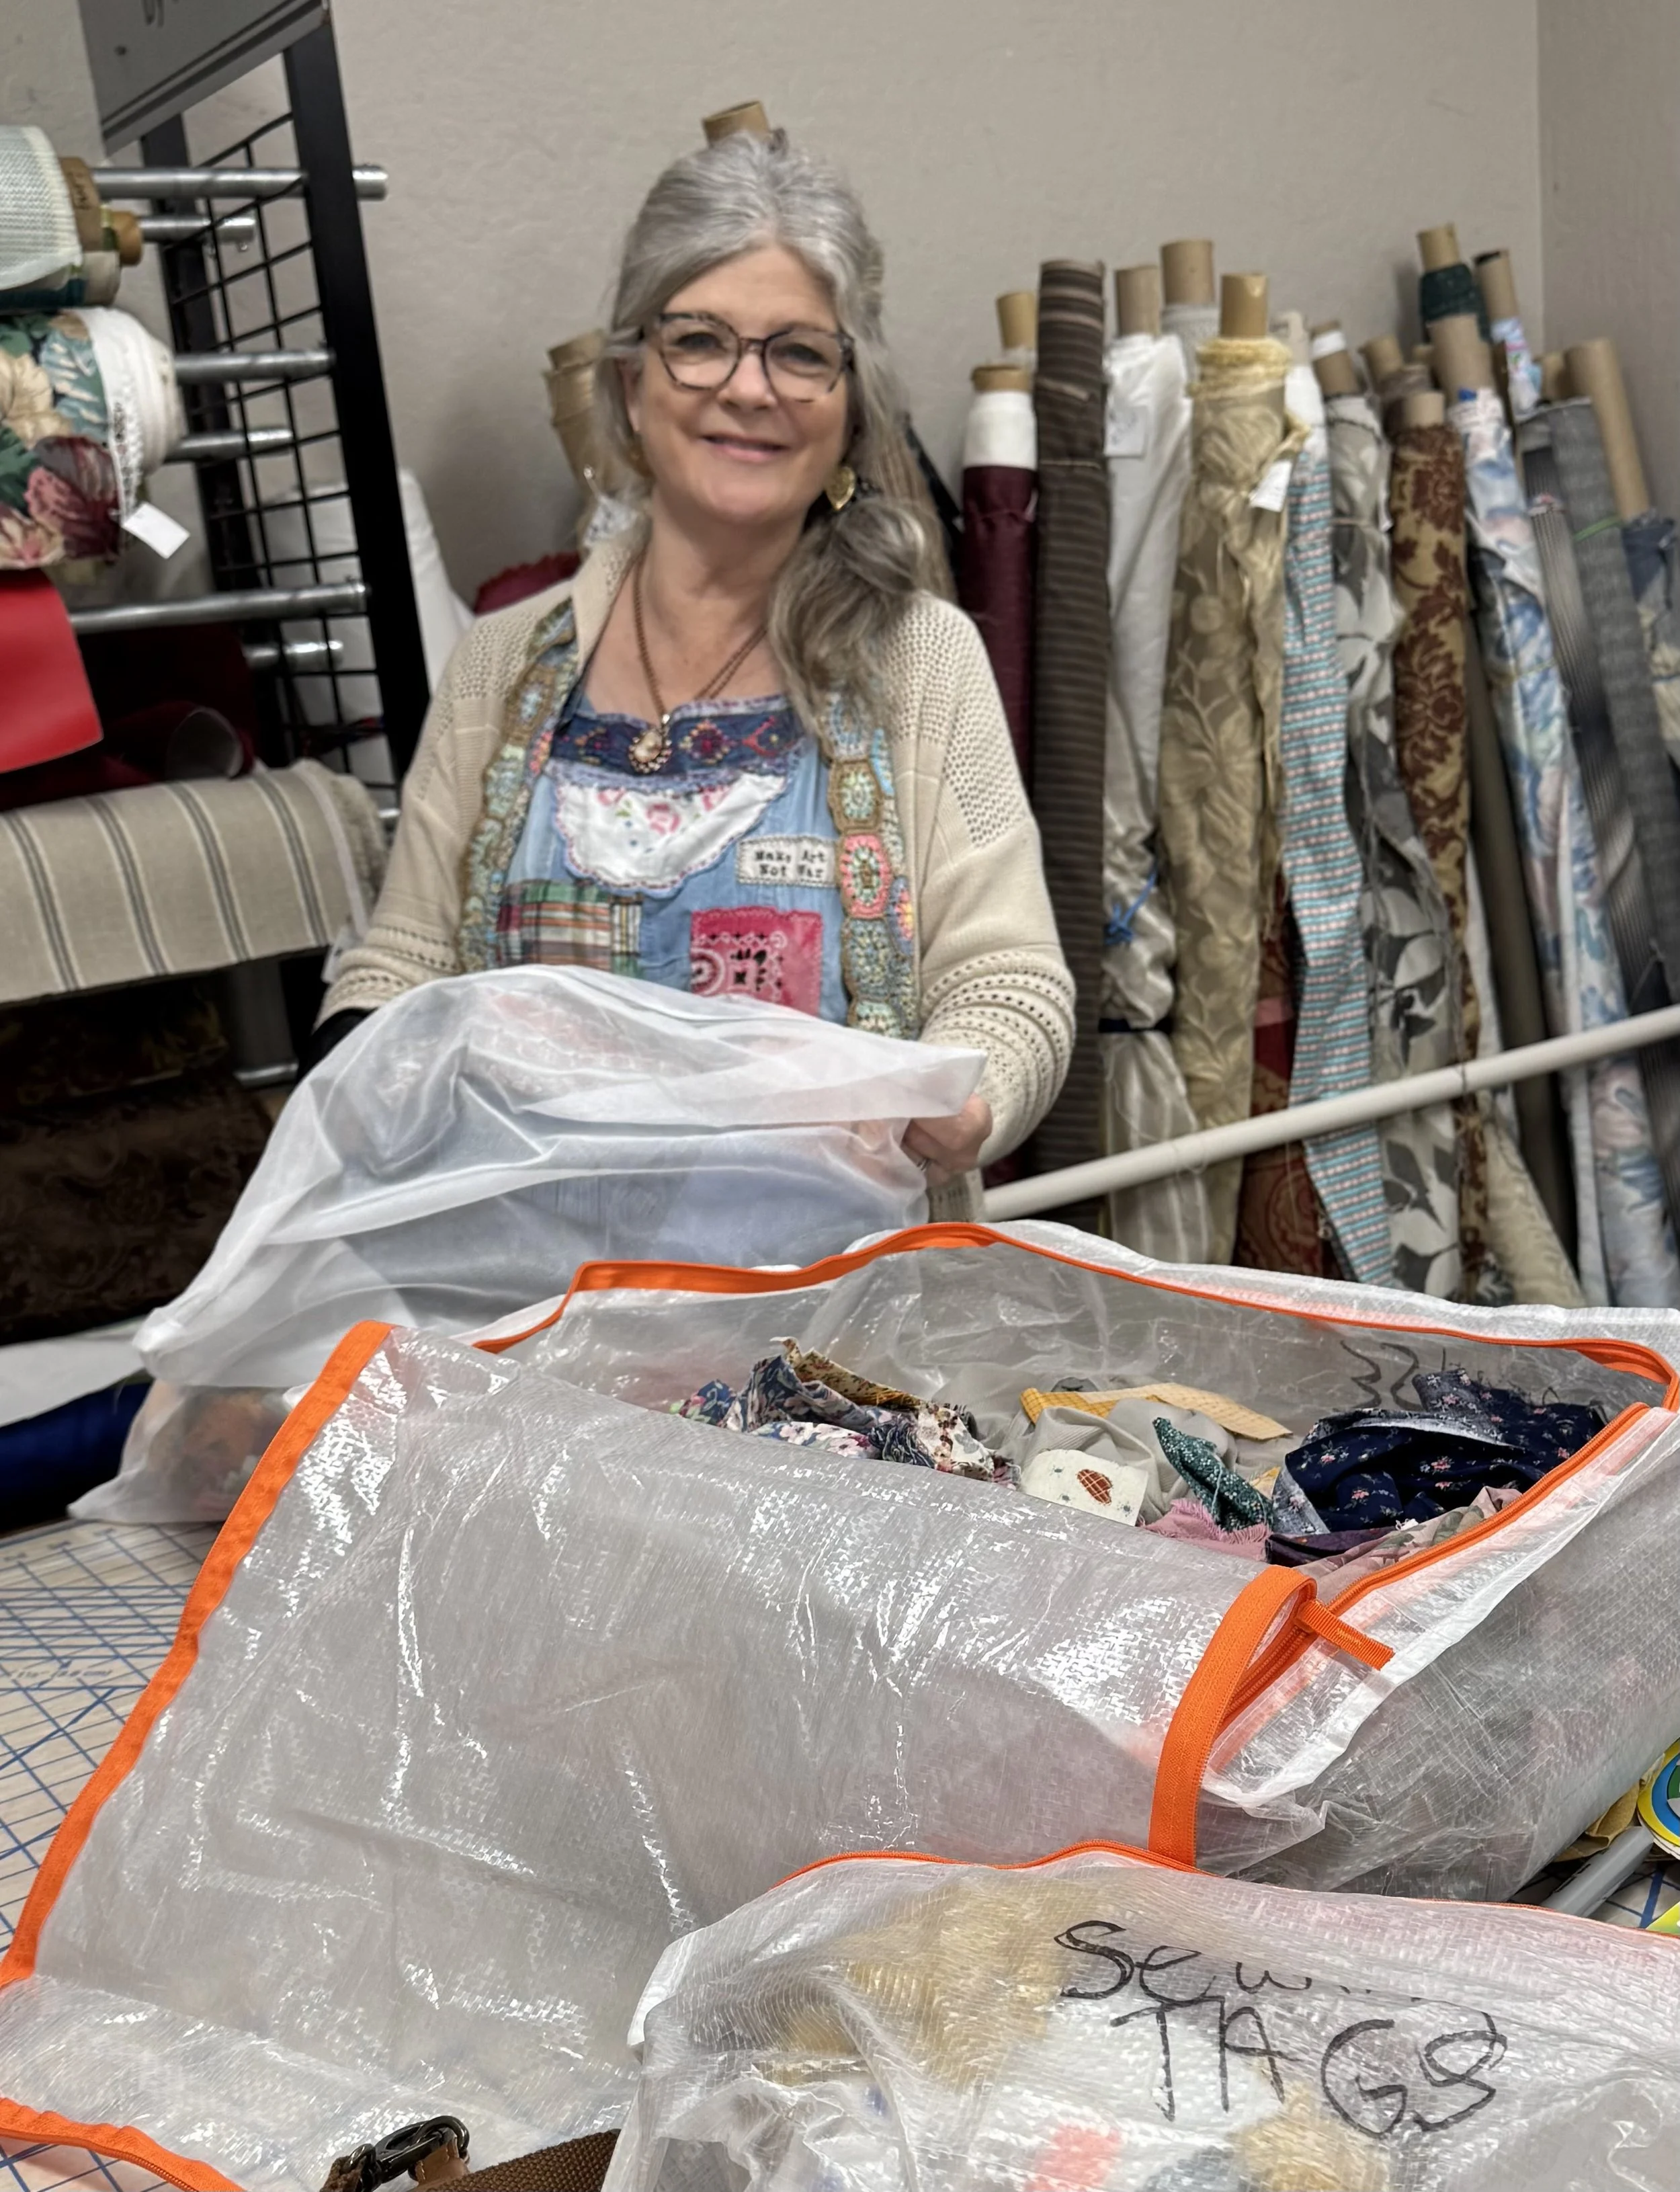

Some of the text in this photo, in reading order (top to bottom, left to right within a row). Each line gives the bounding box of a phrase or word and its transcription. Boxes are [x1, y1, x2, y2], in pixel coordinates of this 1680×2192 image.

[802, 850, 825, 863] Art
[759, 864, 824, 879] Not War
[1110, 1994, 1508, 2139] TAGS
